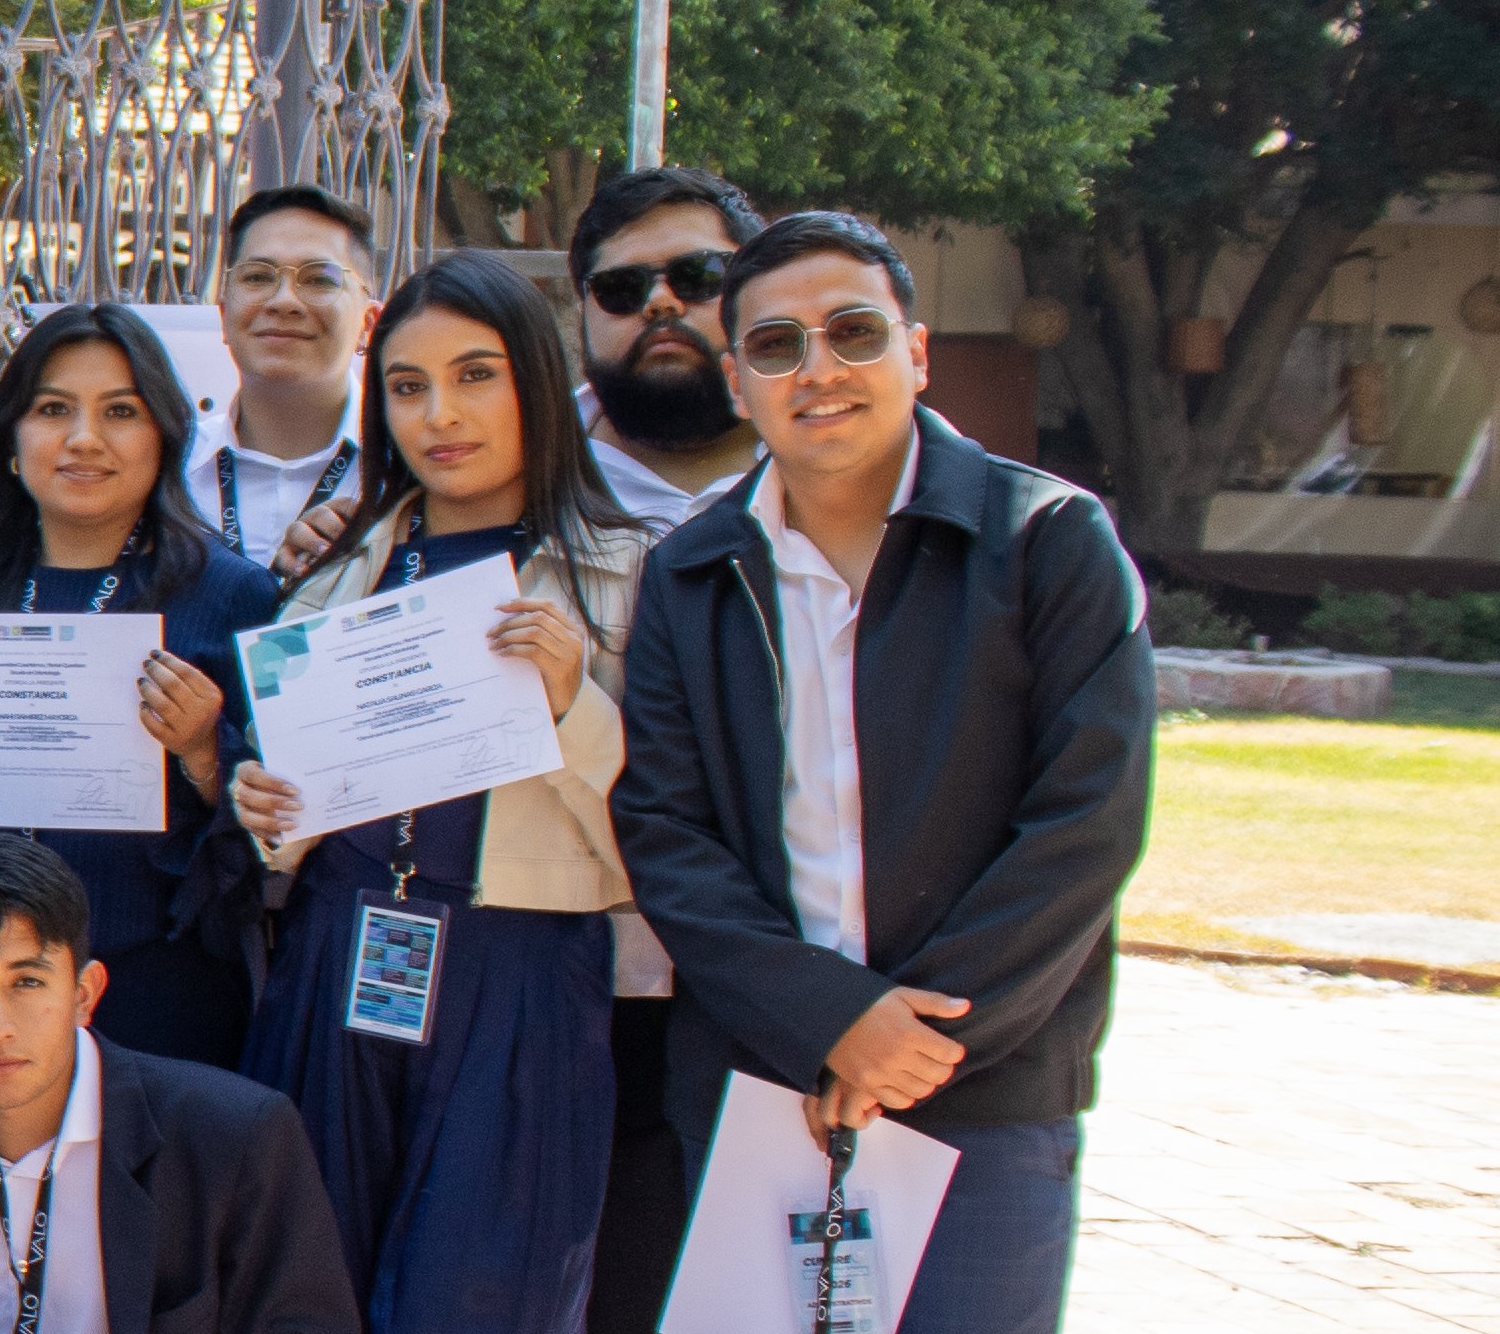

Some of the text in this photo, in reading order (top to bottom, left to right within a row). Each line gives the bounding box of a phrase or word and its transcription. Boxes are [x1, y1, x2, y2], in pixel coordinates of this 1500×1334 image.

[354, 661, 433, 689] CONSTANCIA
[28, 1210, 47, 1264] VALO
[827, 1185, 844, 1237] VALO
[818, 1267, 830, 1321] VALO
